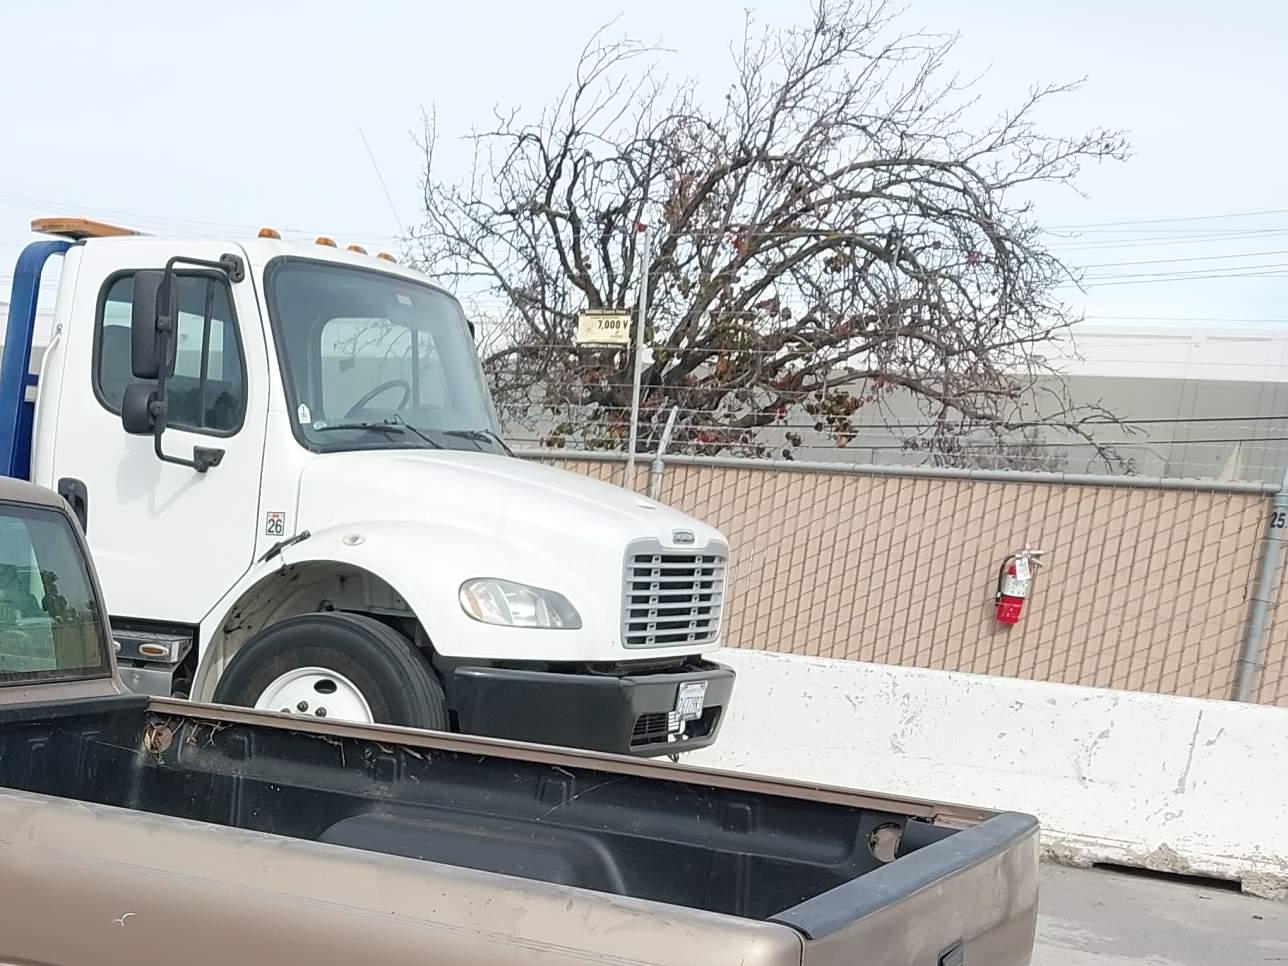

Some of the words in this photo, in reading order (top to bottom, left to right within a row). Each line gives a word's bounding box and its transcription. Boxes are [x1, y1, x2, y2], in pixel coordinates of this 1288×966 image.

[598, 319, 621, 330] 7,000
[623, 320, 629, 330] V
[267, 518, 283, 534] 26
[1270, 511, 1286, 529] 25
